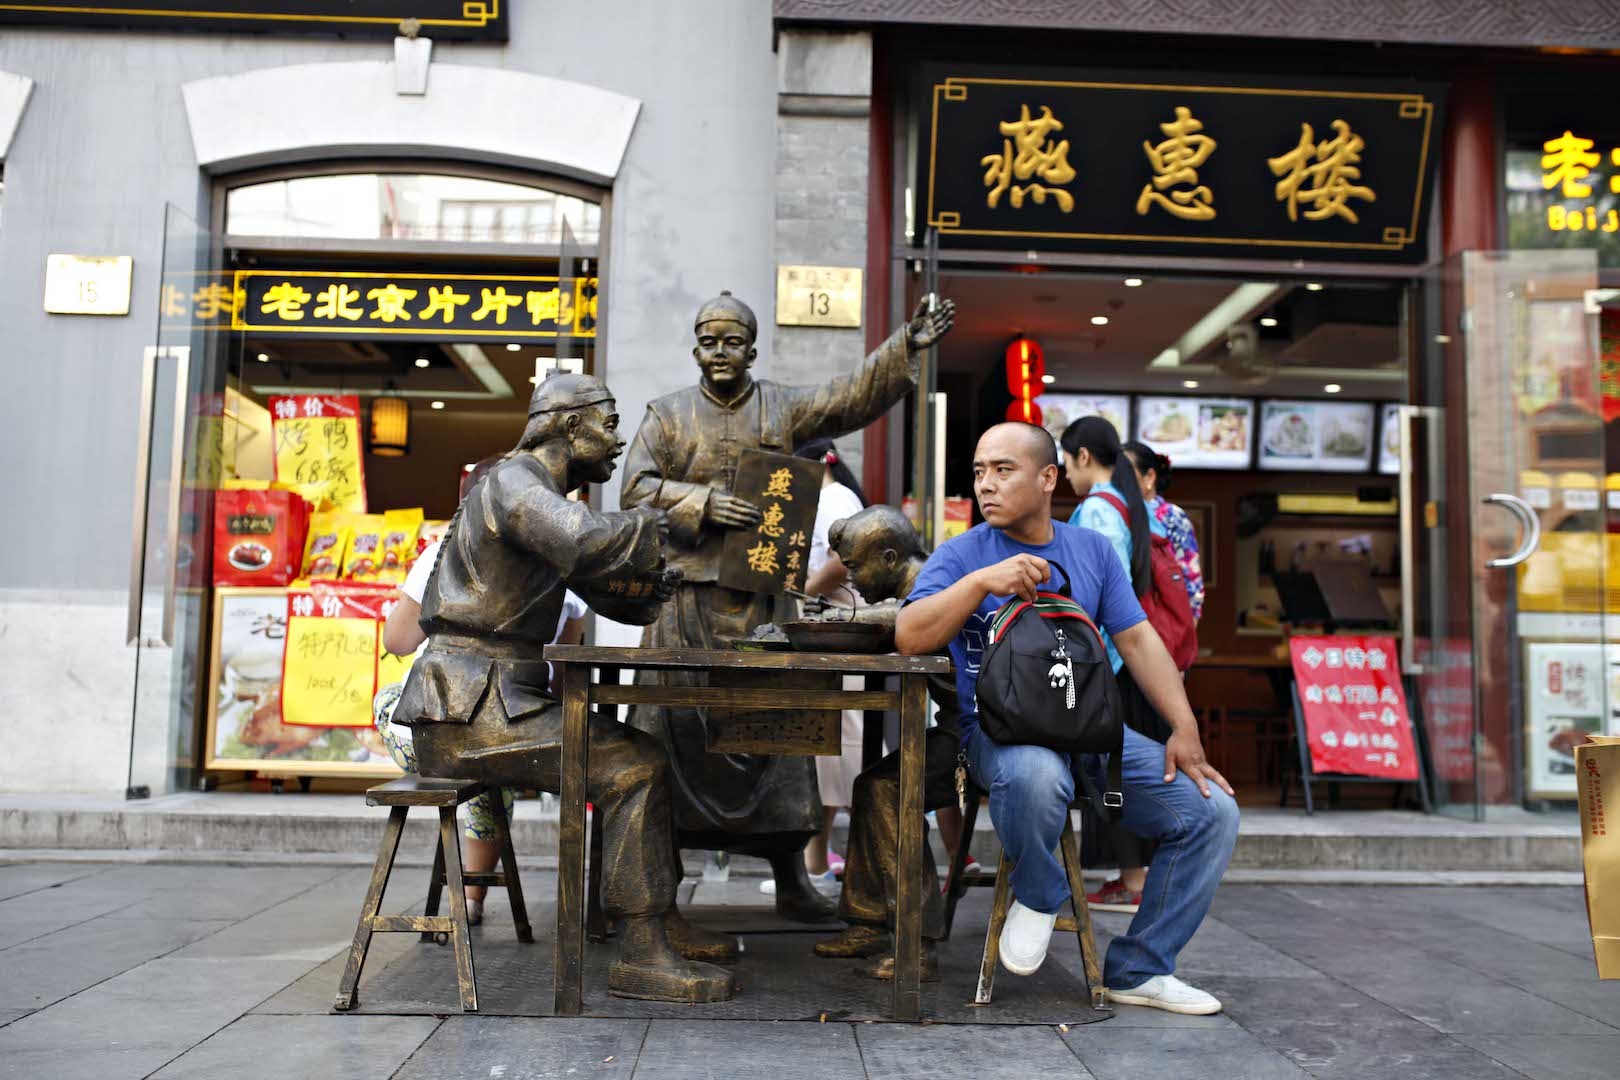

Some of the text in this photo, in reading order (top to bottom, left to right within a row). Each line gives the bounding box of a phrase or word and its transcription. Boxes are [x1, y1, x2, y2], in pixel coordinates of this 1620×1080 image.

[980, 103, 1377, 224] 燕惠楼
[79, 280, 97, 303] 15
[260, 281, 575, 326] 老北京片片鸭
[809, 292, 830, 316] 13
[275, 397, 324, 418] 特价
[747, 467, 794, 576] 燕惠楼
[292, 595, 343, 617] 特价
[1301, 646, 1387, 671] 今日特价
